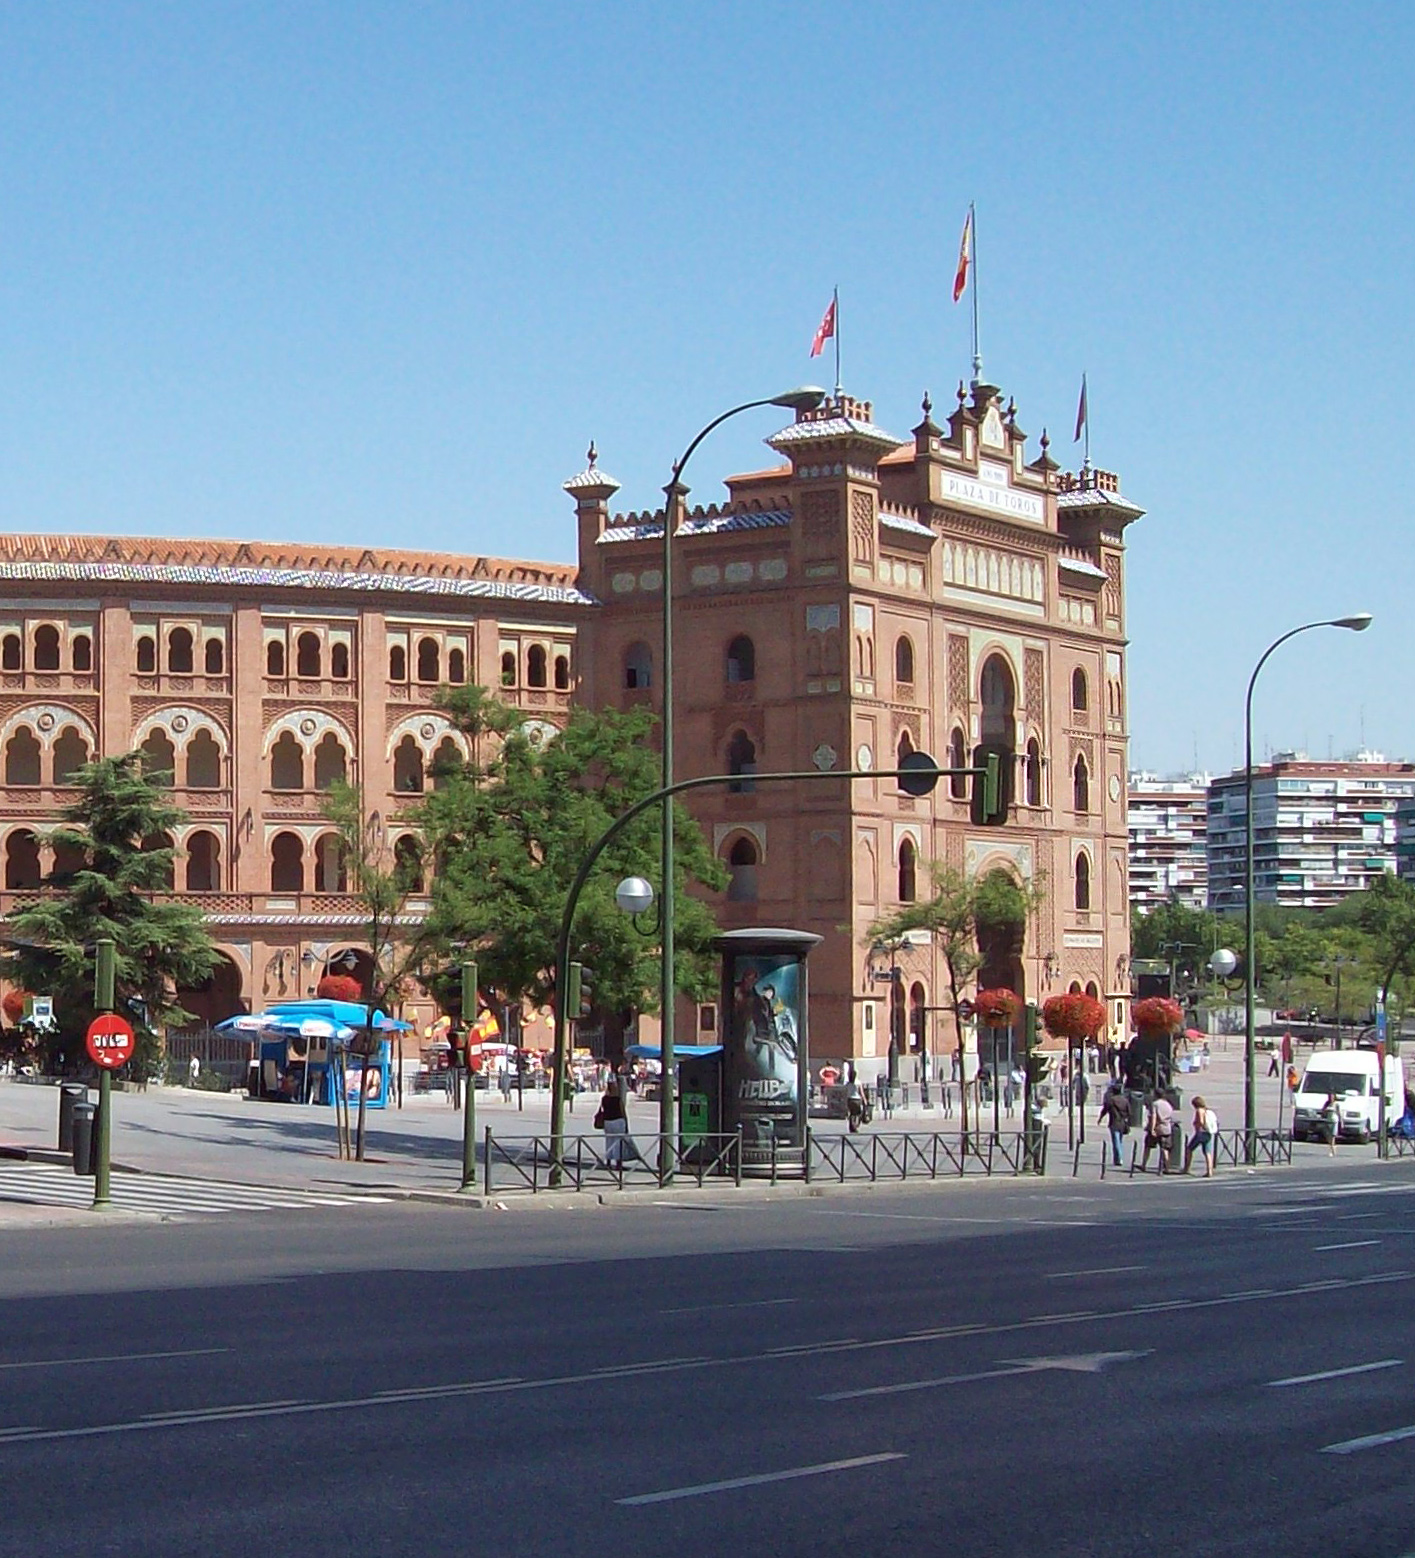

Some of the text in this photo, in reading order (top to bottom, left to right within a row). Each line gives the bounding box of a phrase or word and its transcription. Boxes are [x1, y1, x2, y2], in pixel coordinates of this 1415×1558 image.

[950, 480, 1037, 514] PLAZA DE TOROS
